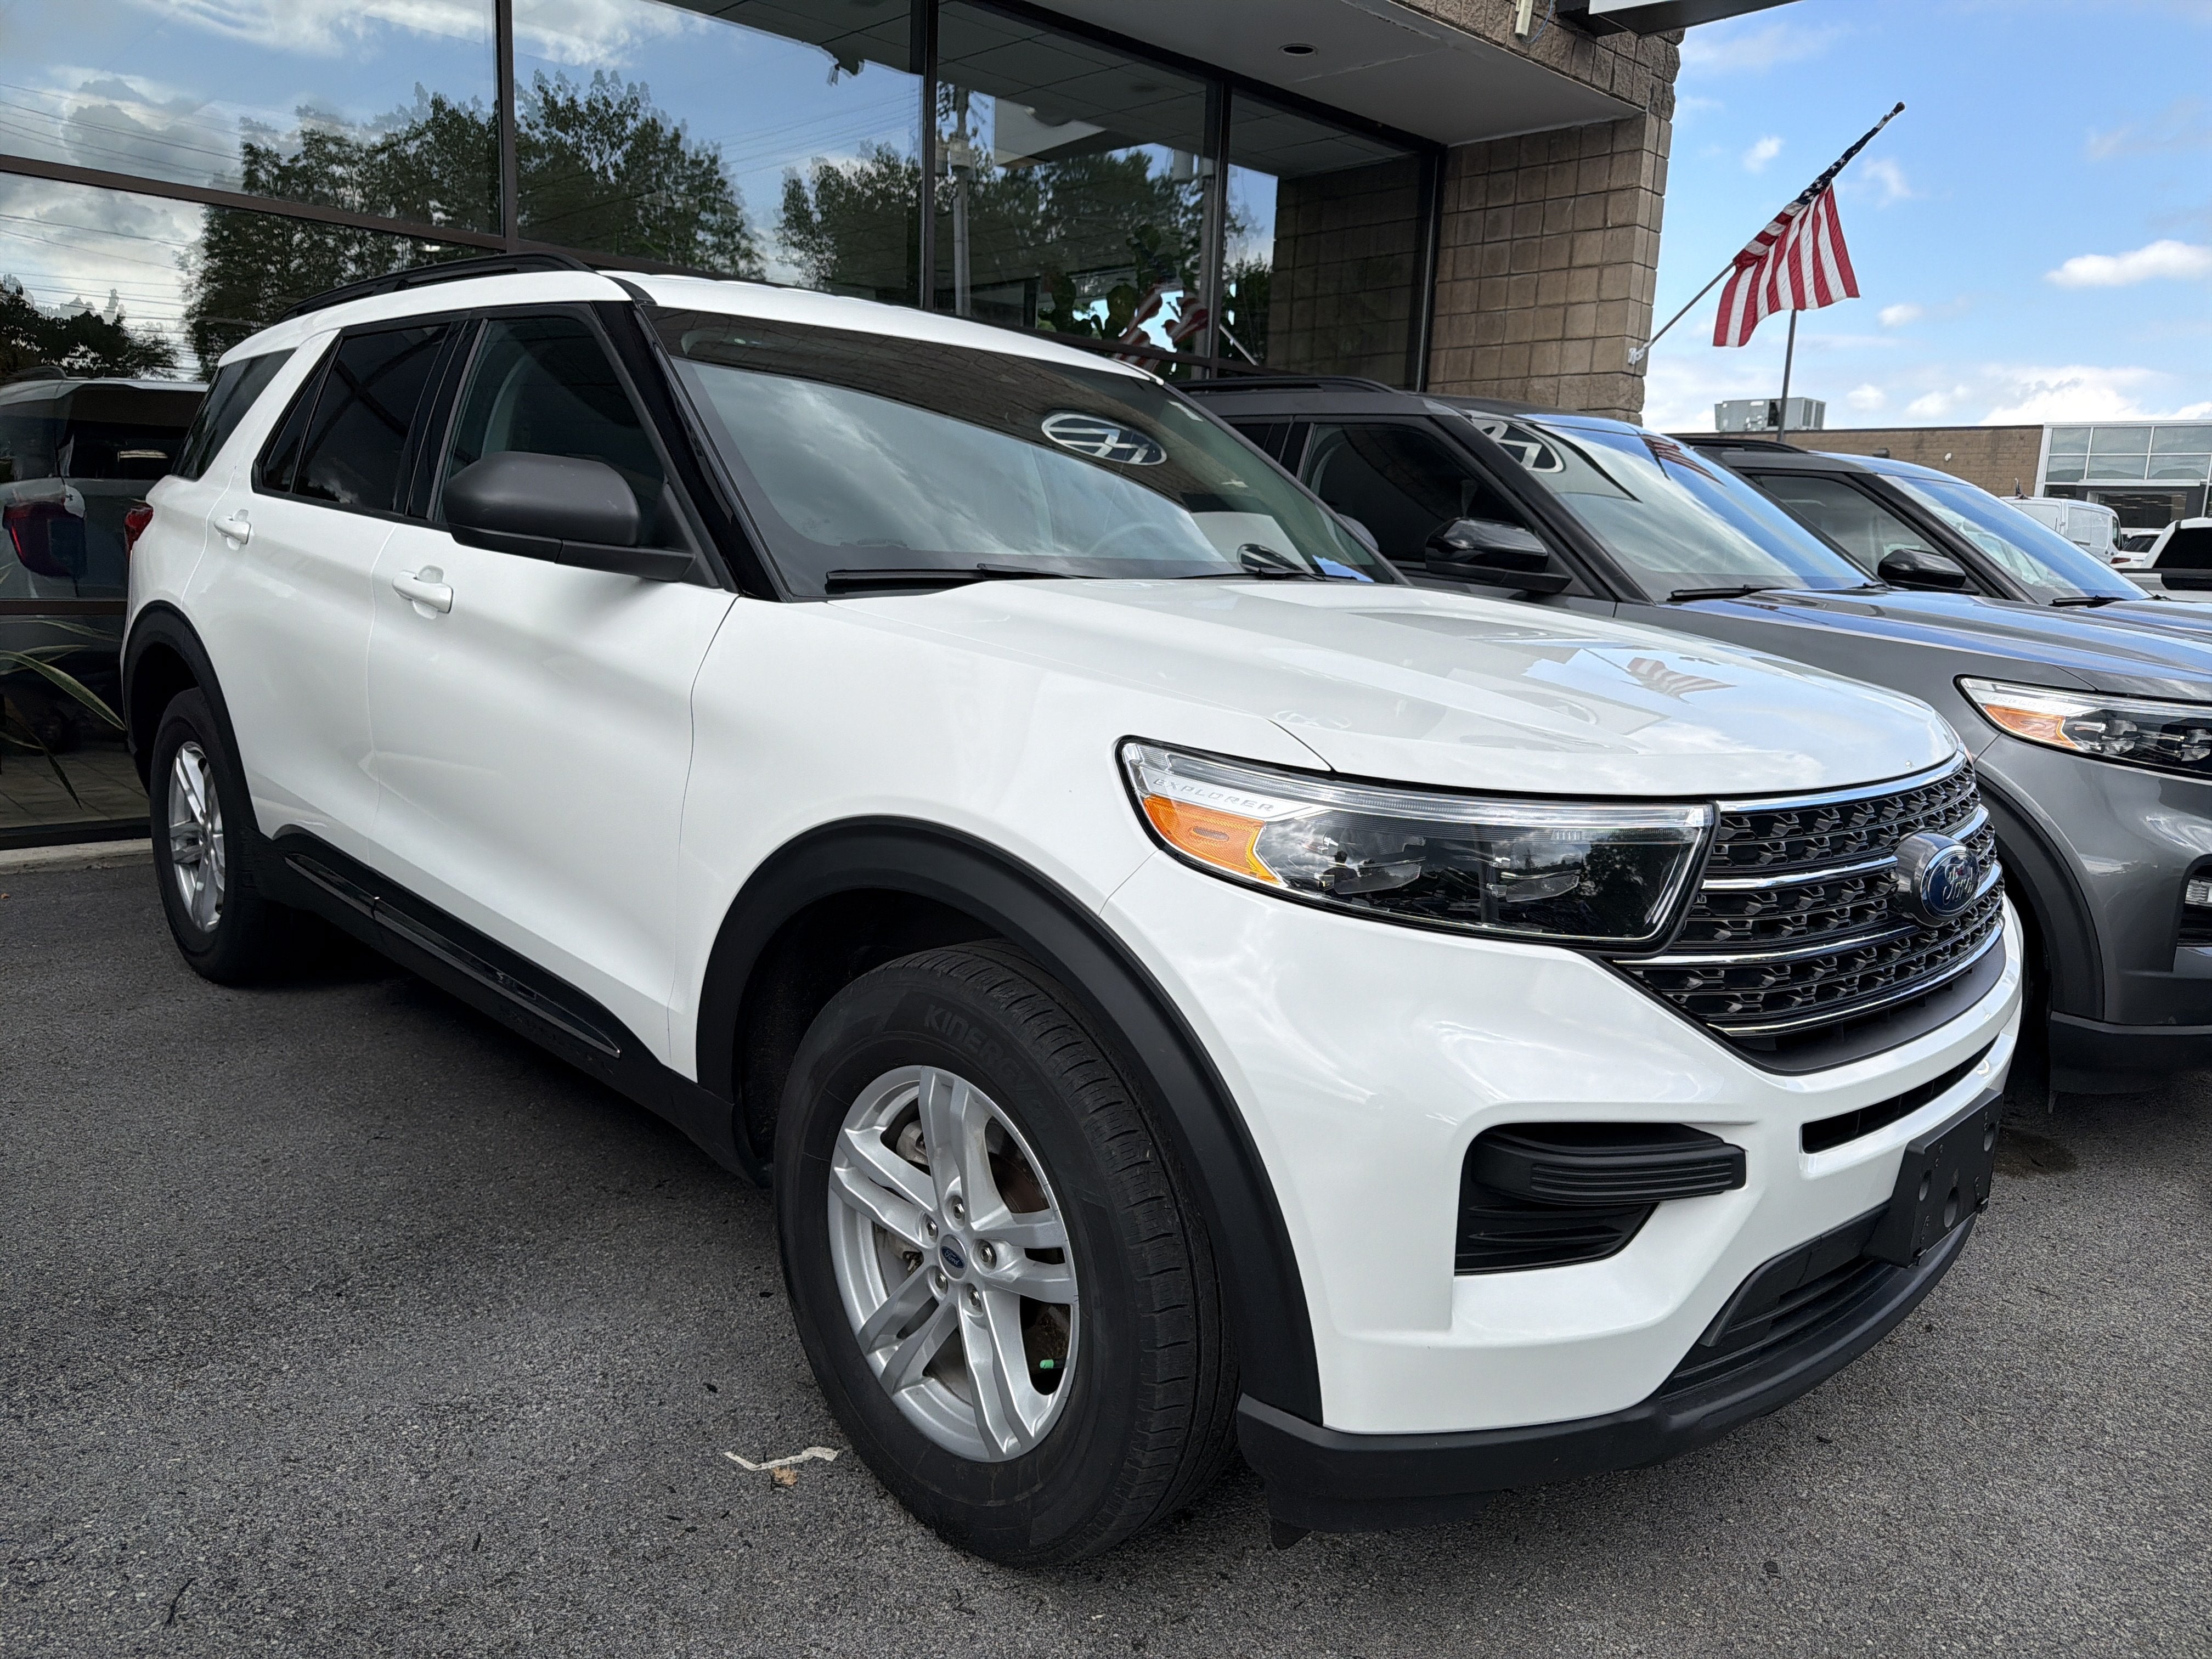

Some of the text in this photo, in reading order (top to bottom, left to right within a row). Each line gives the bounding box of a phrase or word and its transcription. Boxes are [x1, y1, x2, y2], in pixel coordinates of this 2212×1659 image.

[1153, 778, 1274, 812] EXPLORER
[1942, 860, 1974, 906] Ford
[944, 1250, 960, 1266] Ford
